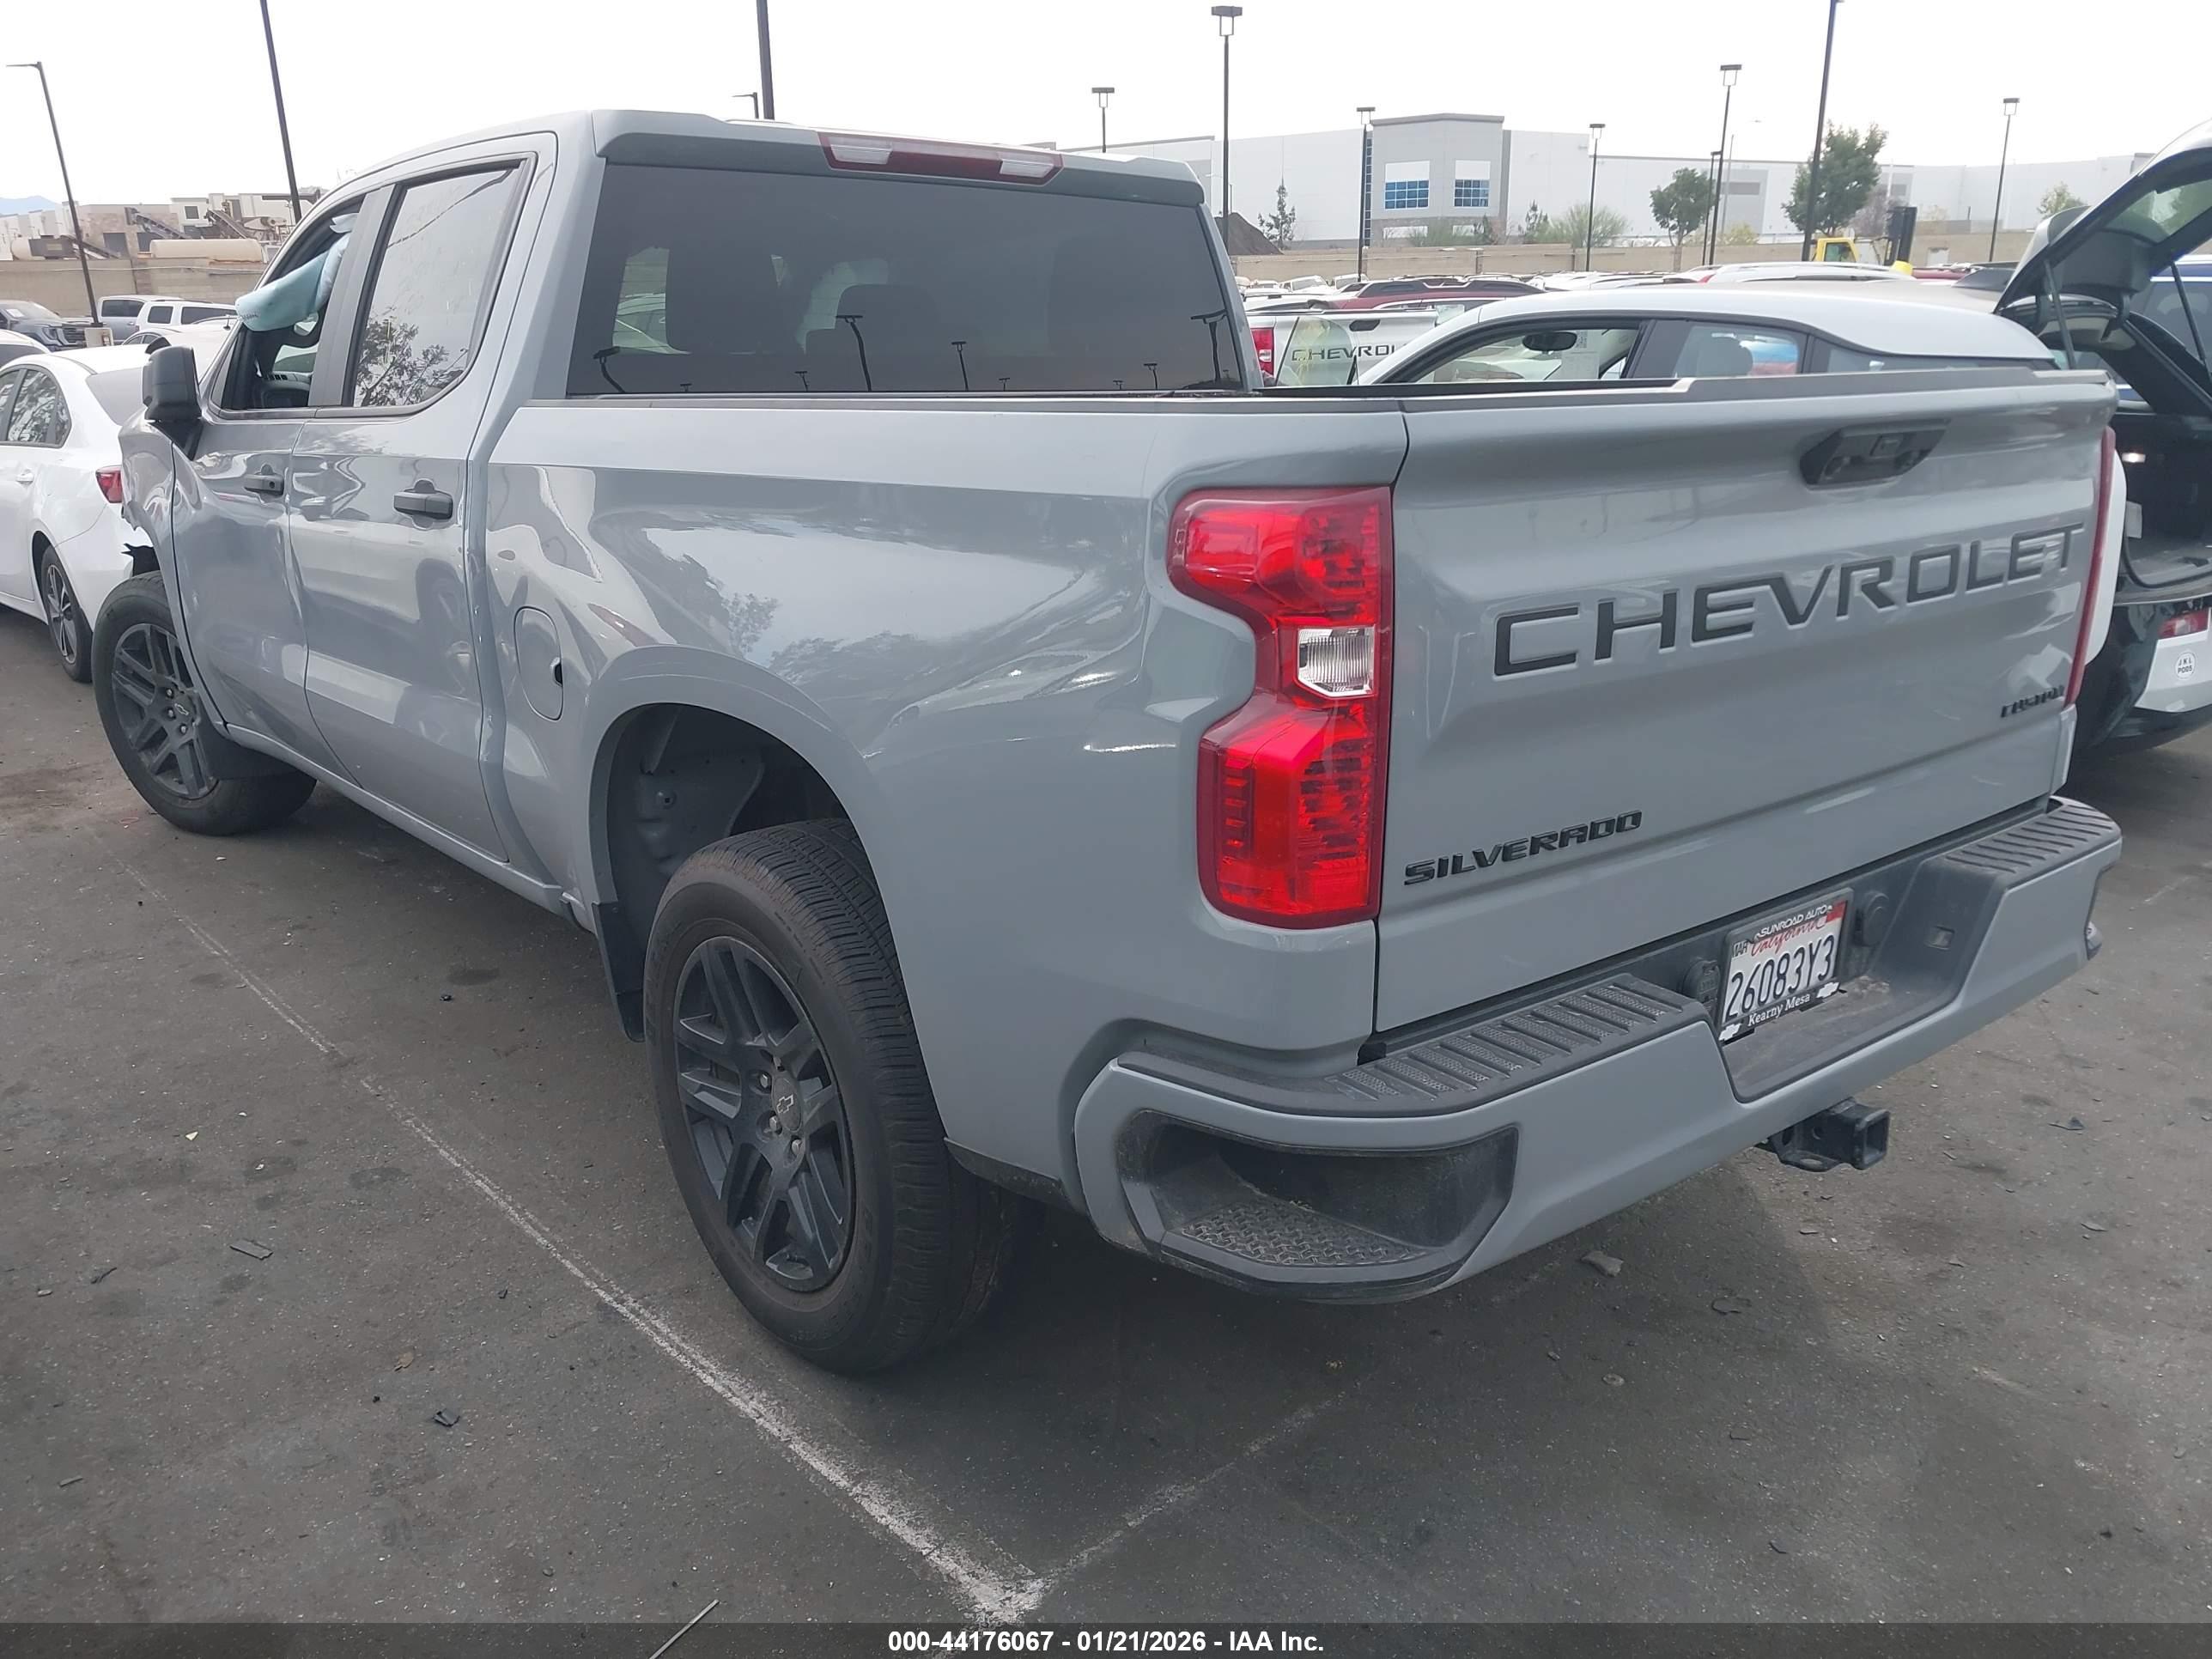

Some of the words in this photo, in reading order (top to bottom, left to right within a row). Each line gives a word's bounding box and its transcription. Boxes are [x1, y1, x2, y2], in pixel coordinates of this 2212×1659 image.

[1493, 521, 2085, 677] CHEVROLET
[1404, 810, 1642, 885] SILVERADO
[1760, 913, 1804, 937] SUNROAD
[1805, 904, 1828, 921] AUTO
[1725, 934, 1835, 1022] 26083Y3
[1747, 1003, 1784, 1026] Kearny
[1784, 994, 1811, 1012] Mesa
